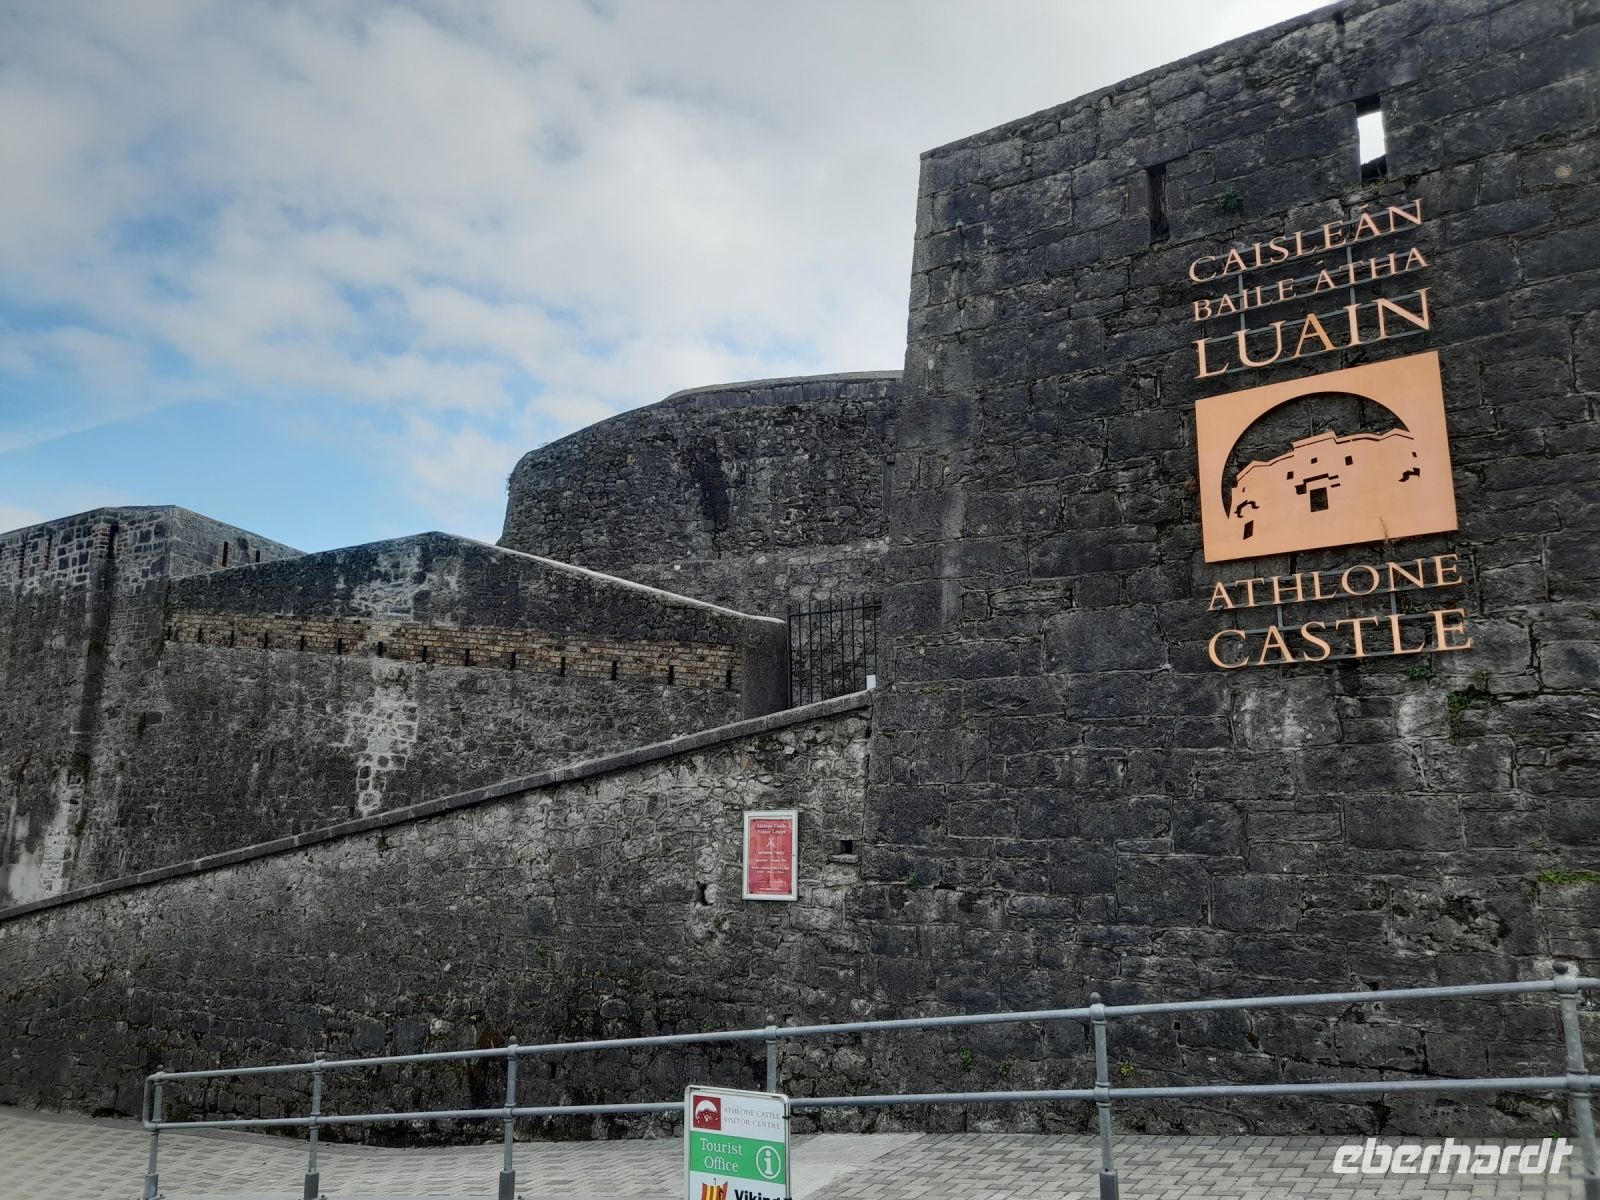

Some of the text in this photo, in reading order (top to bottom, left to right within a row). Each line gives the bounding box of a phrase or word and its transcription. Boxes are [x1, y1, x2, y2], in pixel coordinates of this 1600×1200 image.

[1188, 198, 1423, 283] CAISLEÁN
[1192, 247, 1430, 322] BAILE ÁTHA
[1192, 287, 1432, 379] LUAIN
[1206, 553, 1463, 611] ATHLONE
[1208, 608, 1473, 669] CASTLE
[724, 1106, 782, 1119] ATHLONE CASTLE
[724, 1116, 781, 1130] VISITOR CENTRE
[700, 1138, 743, 1156] Tourist
[704, 1155, 739, 1172] Office
[734, 1189, 781, 1200] Viki
